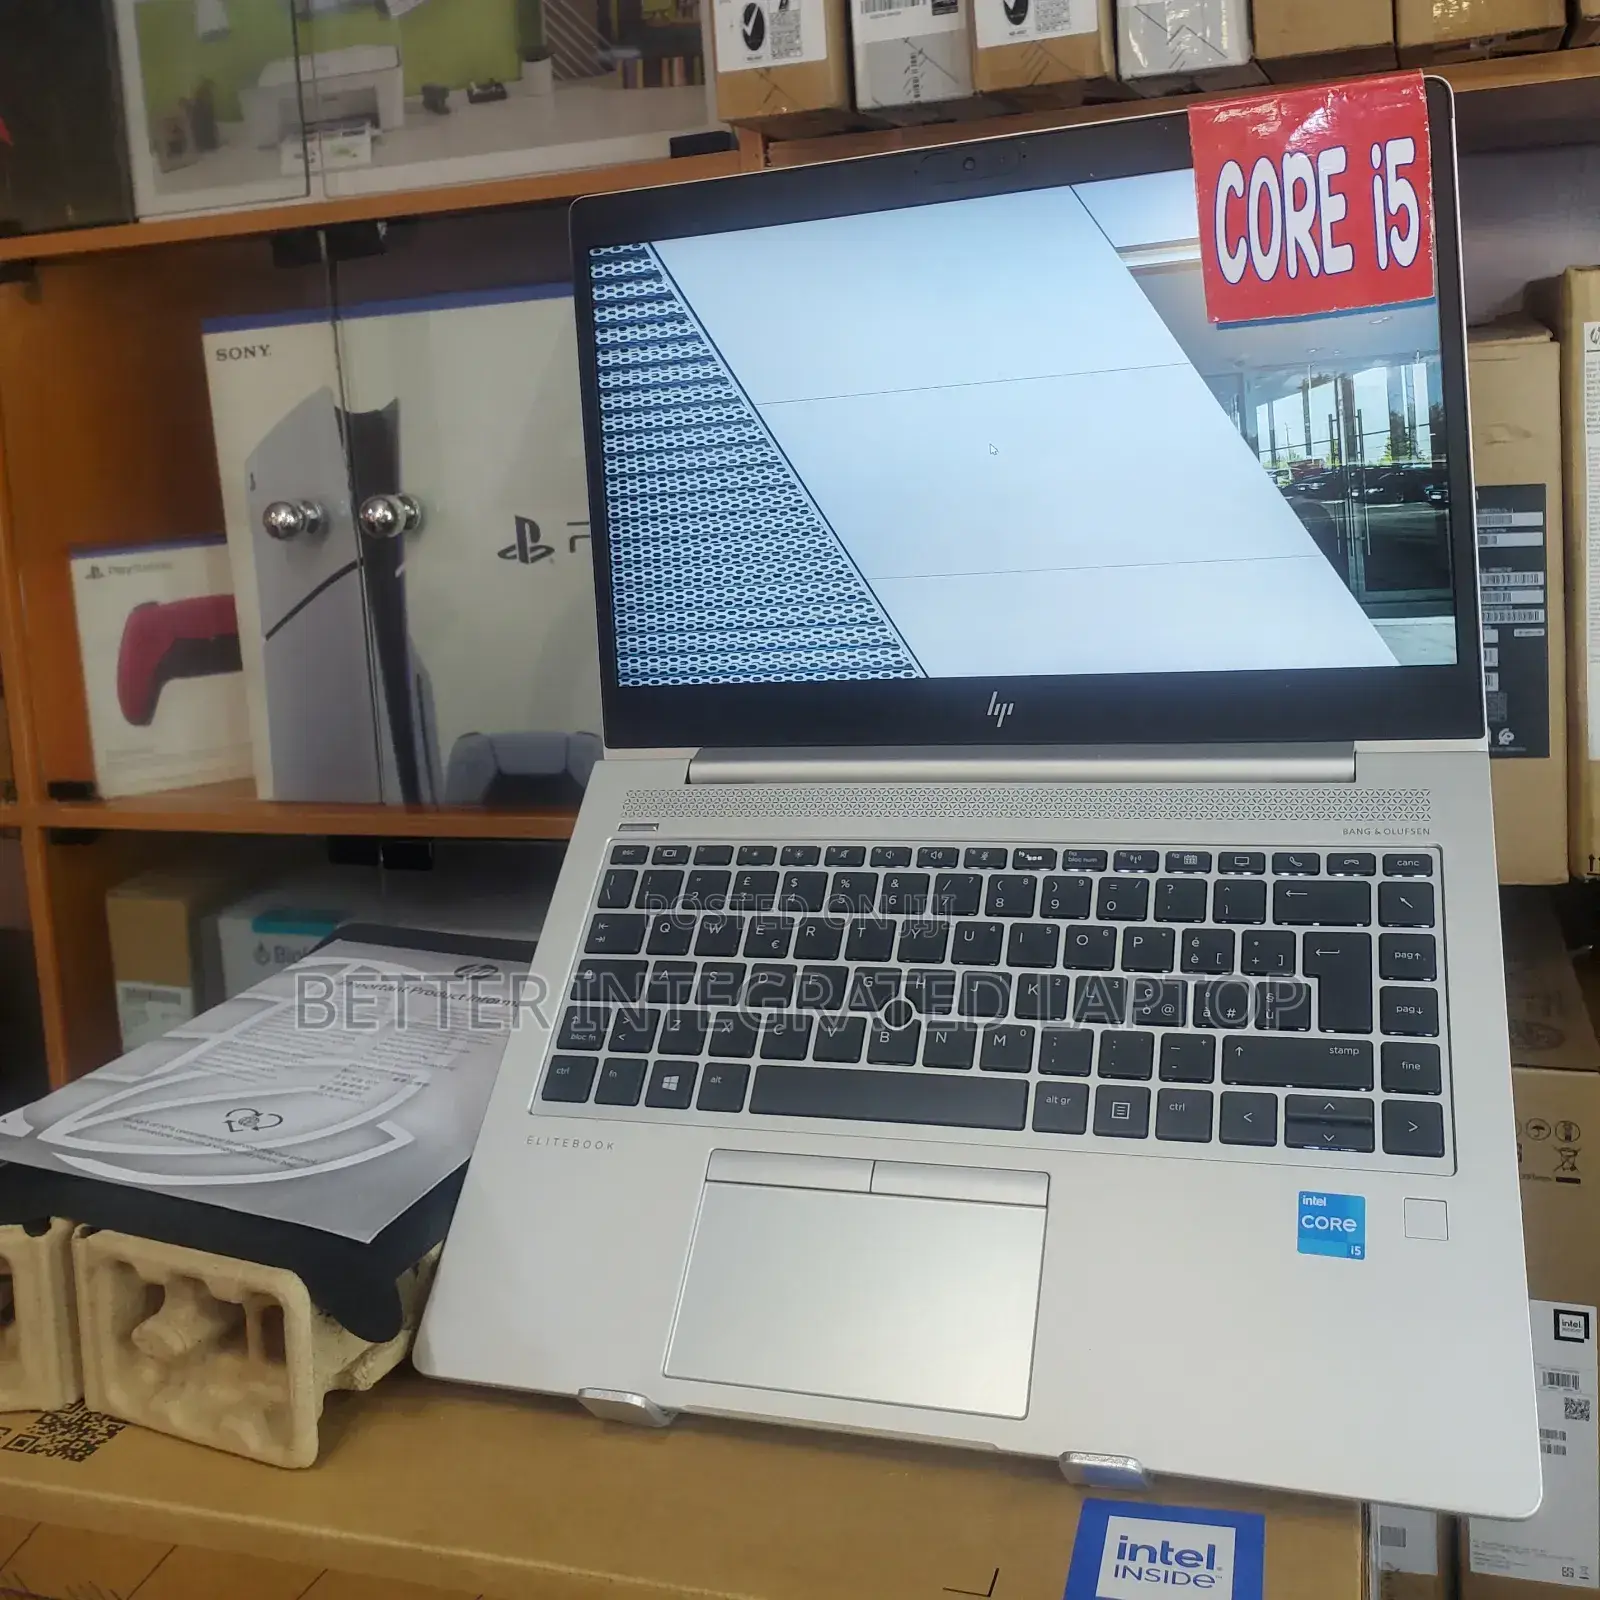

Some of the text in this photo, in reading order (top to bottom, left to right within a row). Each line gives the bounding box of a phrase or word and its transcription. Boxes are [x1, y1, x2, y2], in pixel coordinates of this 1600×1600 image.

[1215, 136, 1420, 285] CORE i5
[215, 343, 271, 361] SONY
[1342, 827, 1371, 836] BANG
[1383, 827, 1431, 836] OLUFSEN
[1397, 858, 1420, 867] canc
[790, 877, 798, 888] $
[841, 879, 850, 888] %
[890, 878, 899, 888] &
[1167, 883, 1174, 894] ?
[888, 895, 897, 904] 6
[995, 897, 1004, 908] 8
[1051, 898, 1060, 909] 9
[659, 922, 671, 935] Q
[708, 924, 723, 935] W
[755, 924, 765, 935] E
[805, 926, 816, 937] R
[857, 927, 867, 938] T
[910, 928, 921, 939] Y
[963, 931, 975, 942] U
[1076, 934, 1089, 946] O
[1133, 936, 1143, 948] P
[770, 939, 780, 950] €
[1394, 950, 1414, 962] pag
[659, 970, 669, 981] A
[708, 971, 718, 982] S
[758, 973, 769, 983] D
[808, 974, 818, 986] F
[863, 976, 873, 988] G
[915, 978, 926, 989] H
[970, 981, 979, 992] J
[1027, 984, 1038, 995] K
[1085, 986, 1095, 998] L
[1161, 1003, 1175, 1016] @
[1226, 1008, 1237, 1018] #
[1396, 1004, 1415, 1016] pag
[671, 1020, 681, 1031] Z
[721, 1022, 732, 1033] X
[773, 1024, 784, 1035] C
[827, 1026, 837, 1037] V
[570, 1033, 586, 1042] bloc
[879, 1032, 890, 1043] B
[935, 1032, 947, 1044] N
[994, 1035, 1006, 1047] M
[1329, 1045, 1360, 1057] stamp
[556, 1066, 570, 1076] ctrl
[1400, 1060, 1422, 1071] fine
[608, 1069, 618, 1079] fn
[710, 1075, 722, 1085] alt
[1046, 1095, 1071, 1106] alt gr
[1169, 1102, 1185, 1112] ctrl
[526, 1135, 615, 1150] ELITEBOOK
[1302, 1195, 1327, 1207] intel
[1350, 1245, 1362, 1256] i5
